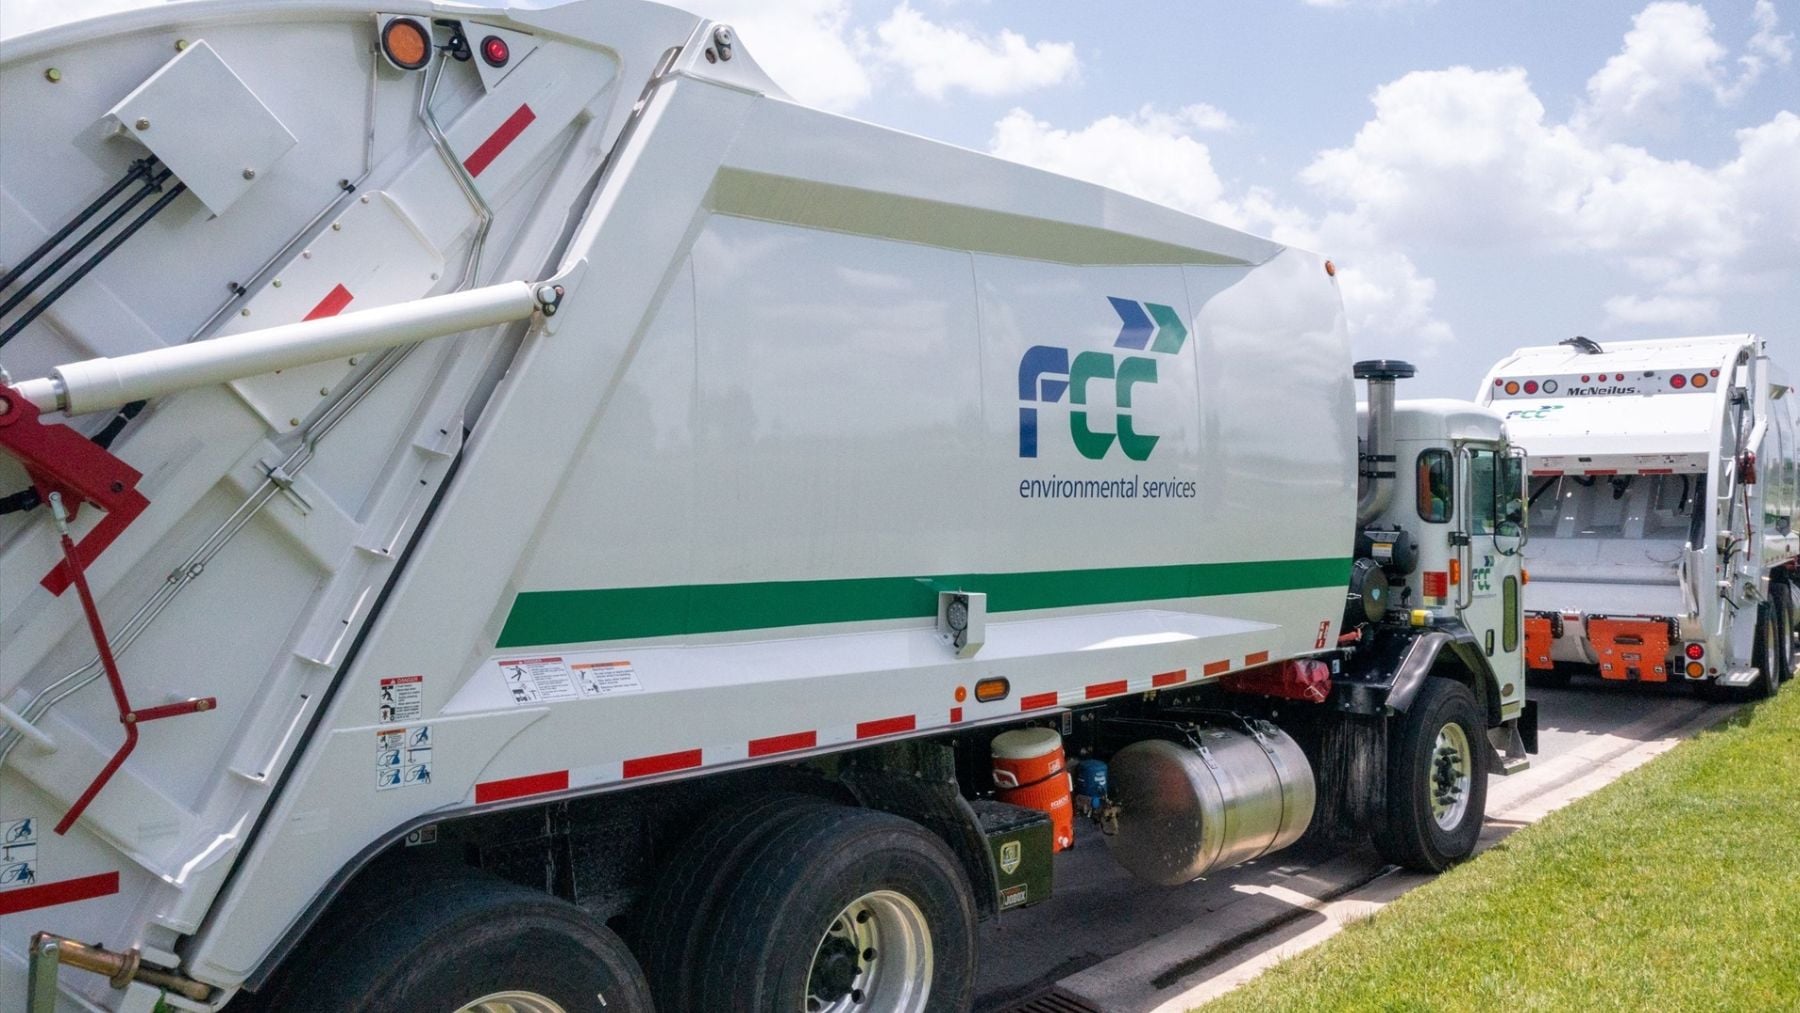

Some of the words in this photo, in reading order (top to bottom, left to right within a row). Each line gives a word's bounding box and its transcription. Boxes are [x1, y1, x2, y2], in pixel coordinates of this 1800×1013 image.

[1019, 345, 1160, 461] FCC
[1567, 386, 1635, 396] McNeilus
[1019, 474, 1138, 498] environmental
[1142, 476, 1196, 498] services
